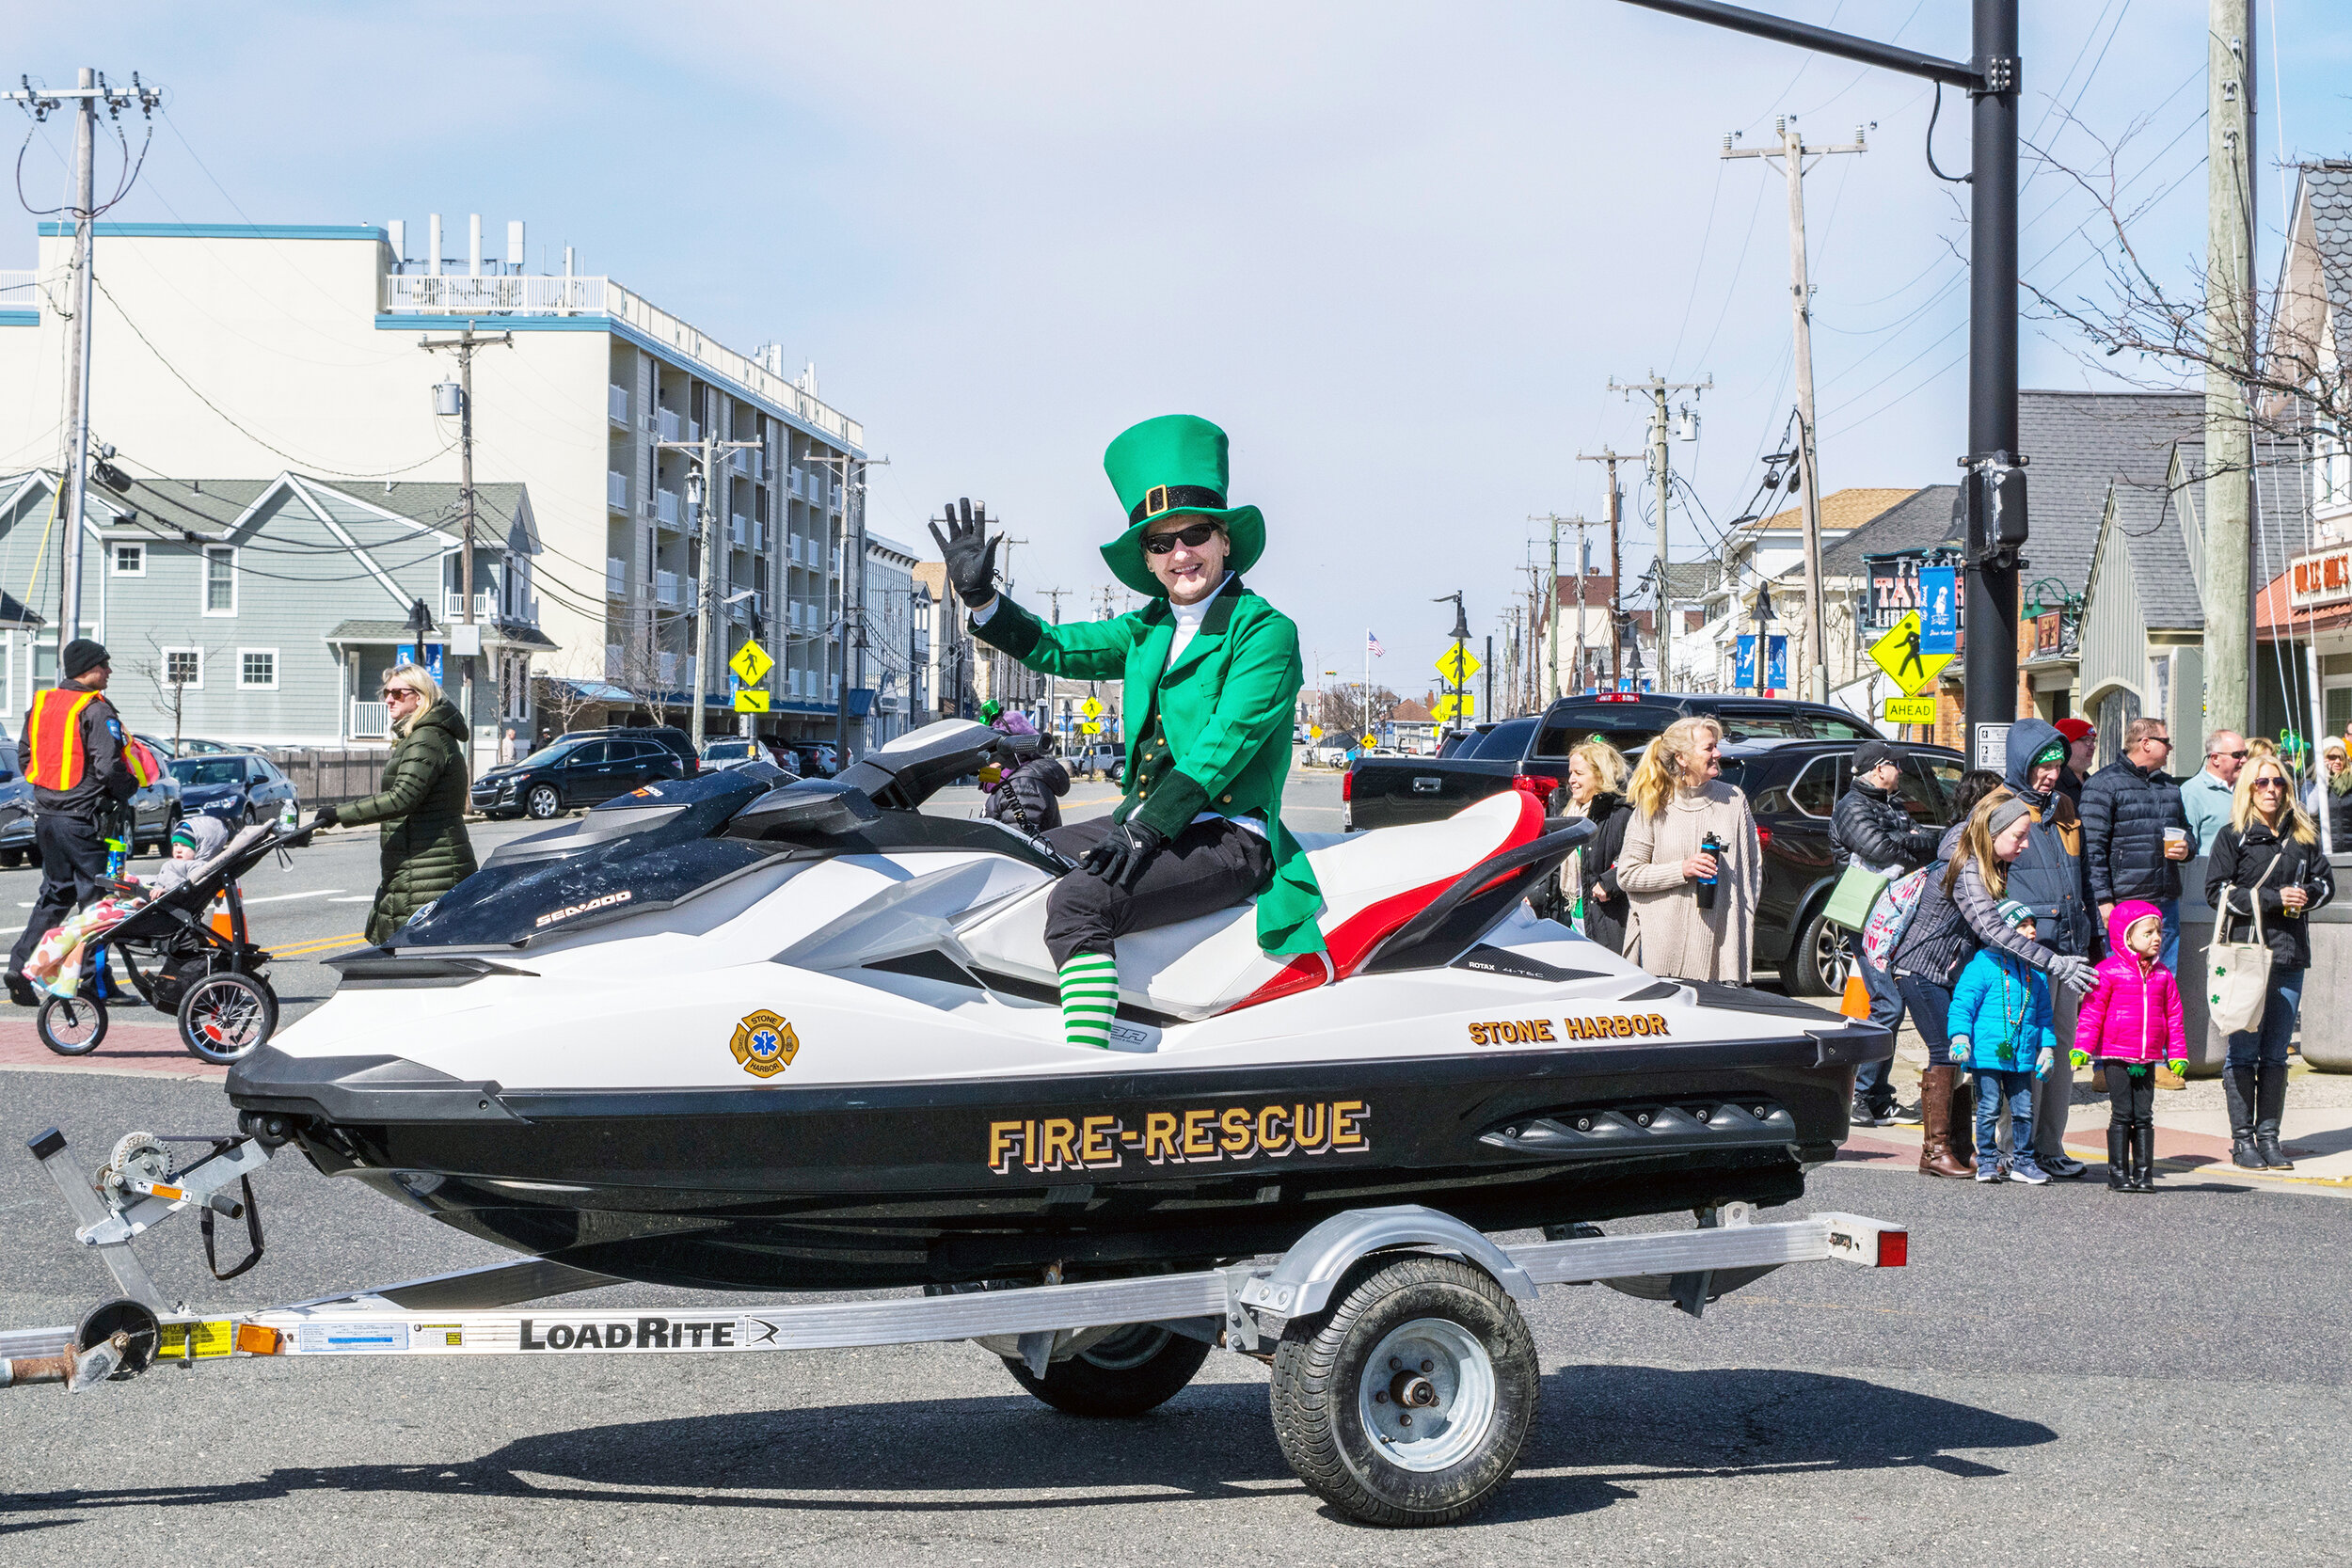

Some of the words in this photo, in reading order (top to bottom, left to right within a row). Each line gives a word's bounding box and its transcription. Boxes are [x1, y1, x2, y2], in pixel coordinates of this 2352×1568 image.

[1890, 705, 1931, 716] AHEAD
[1469, 961, 1496, 971] ROTAX
[751, 1015, 778, 1025] STONE
[1468, 1019, 1558, 1046] STONE
[1564, 1013, 1672, 1041] HARBOR
[750, 1062, 780, 1073] HARBOR
[988, 1100, 1372, 1175] FIRE-RESCUE
